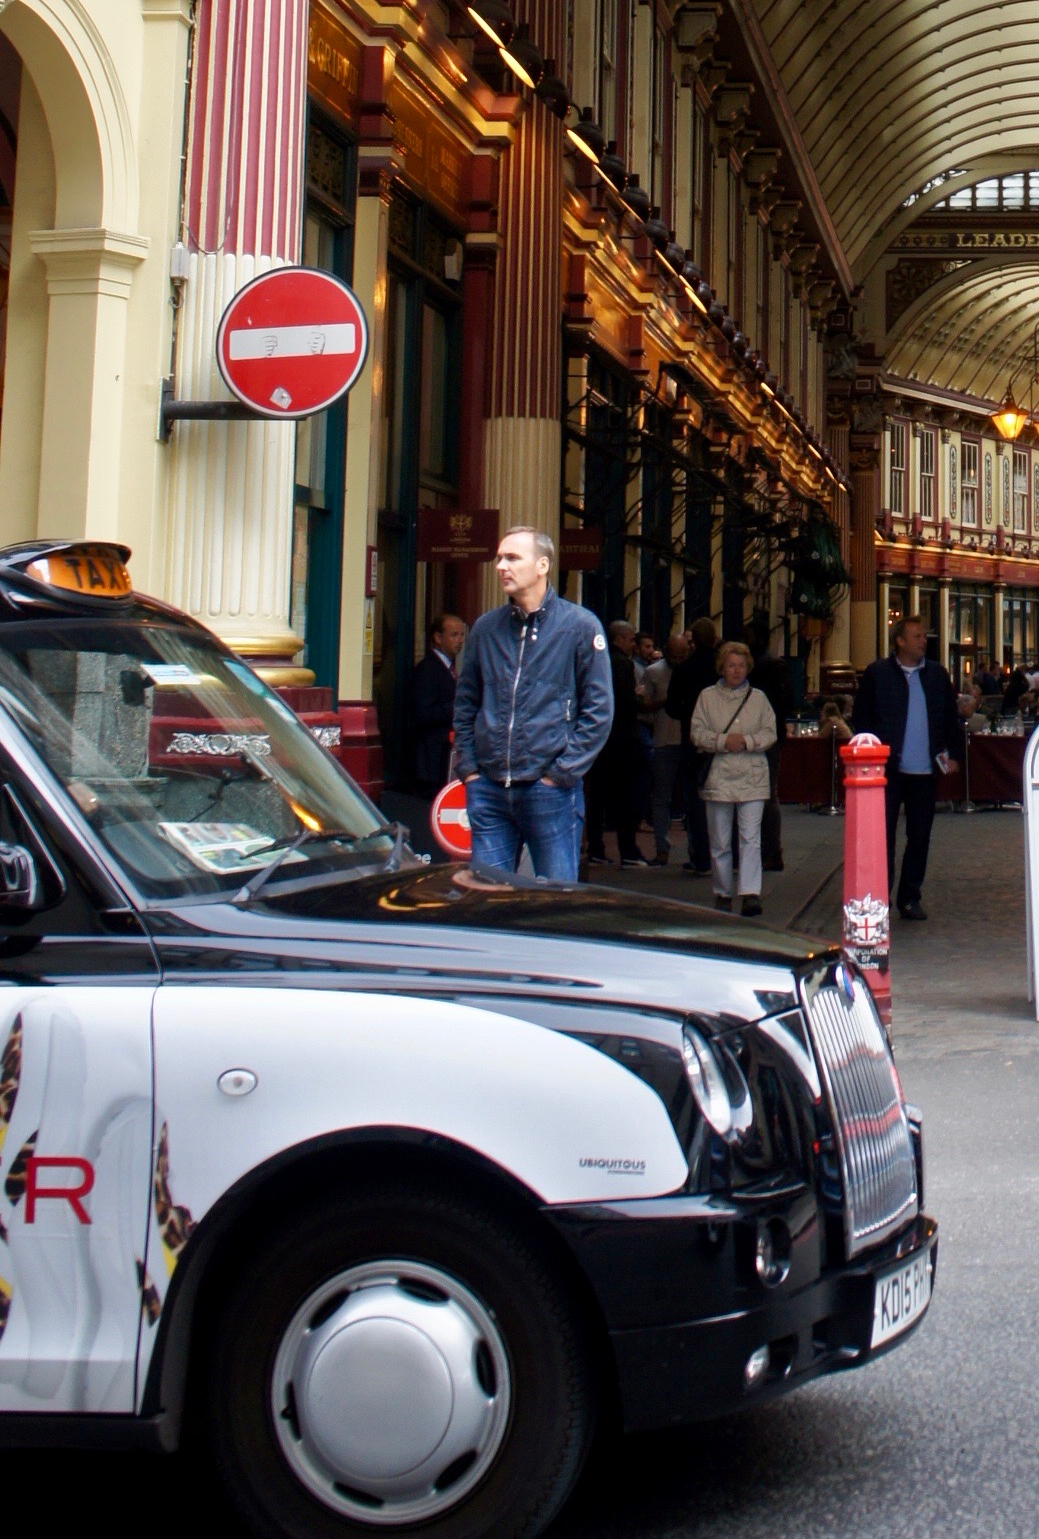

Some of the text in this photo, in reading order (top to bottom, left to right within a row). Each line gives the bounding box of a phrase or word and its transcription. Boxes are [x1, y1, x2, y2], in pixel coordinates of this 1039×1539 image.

[65, 558, 128, 592] TAXI
[861, 955, 871, 963] OF
[578, 1158, 647, 1170] UBIQUITOUS
